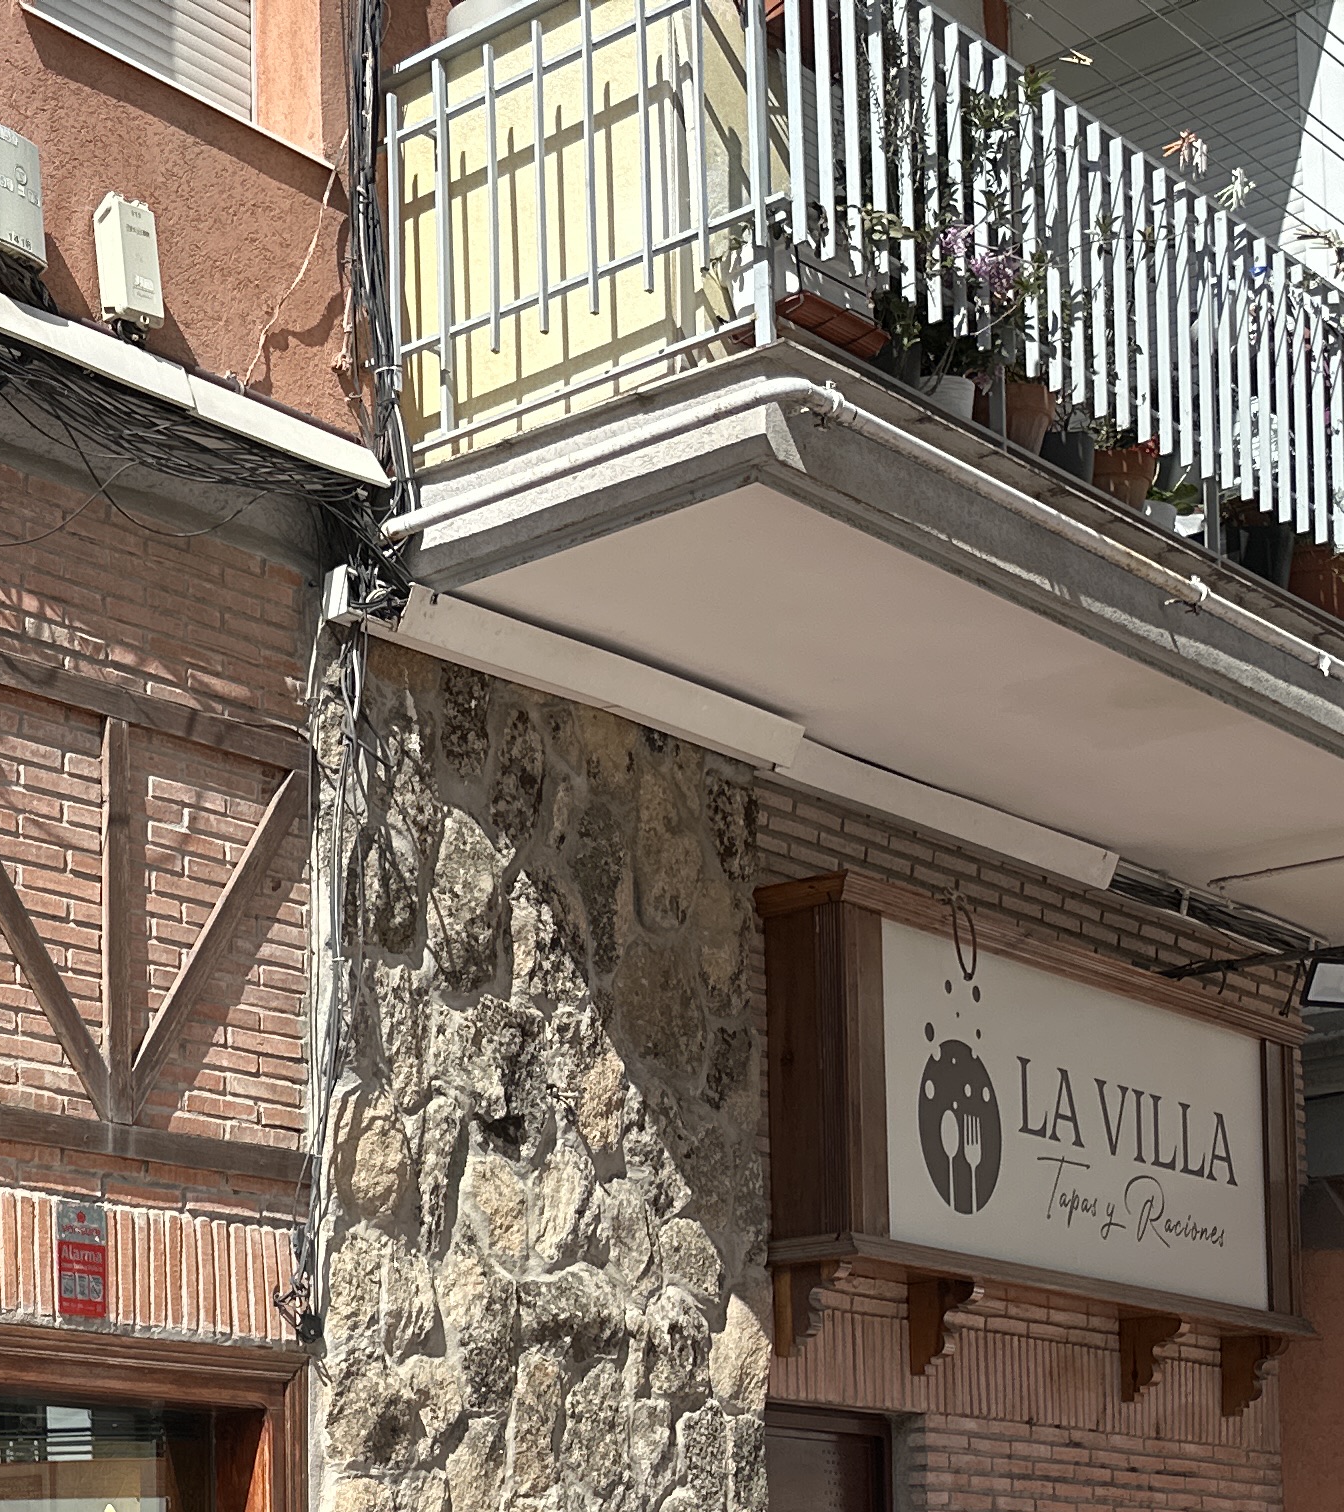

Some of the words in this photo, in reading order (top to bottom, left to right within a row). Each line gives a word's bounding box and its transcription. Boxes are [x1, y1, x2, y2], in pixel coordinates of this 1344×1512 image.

[1016, 1056, 1085, 1150] LA
[1093, 1077, 1239, 1187] VILLA
[1036, 1155, 1097, 1229] Tapas
[1103, 1199, 1127, 1235] y
[1124, 1175, 1226, 1249] Raciones
[61, 1244, 103, 1264] Alarma
